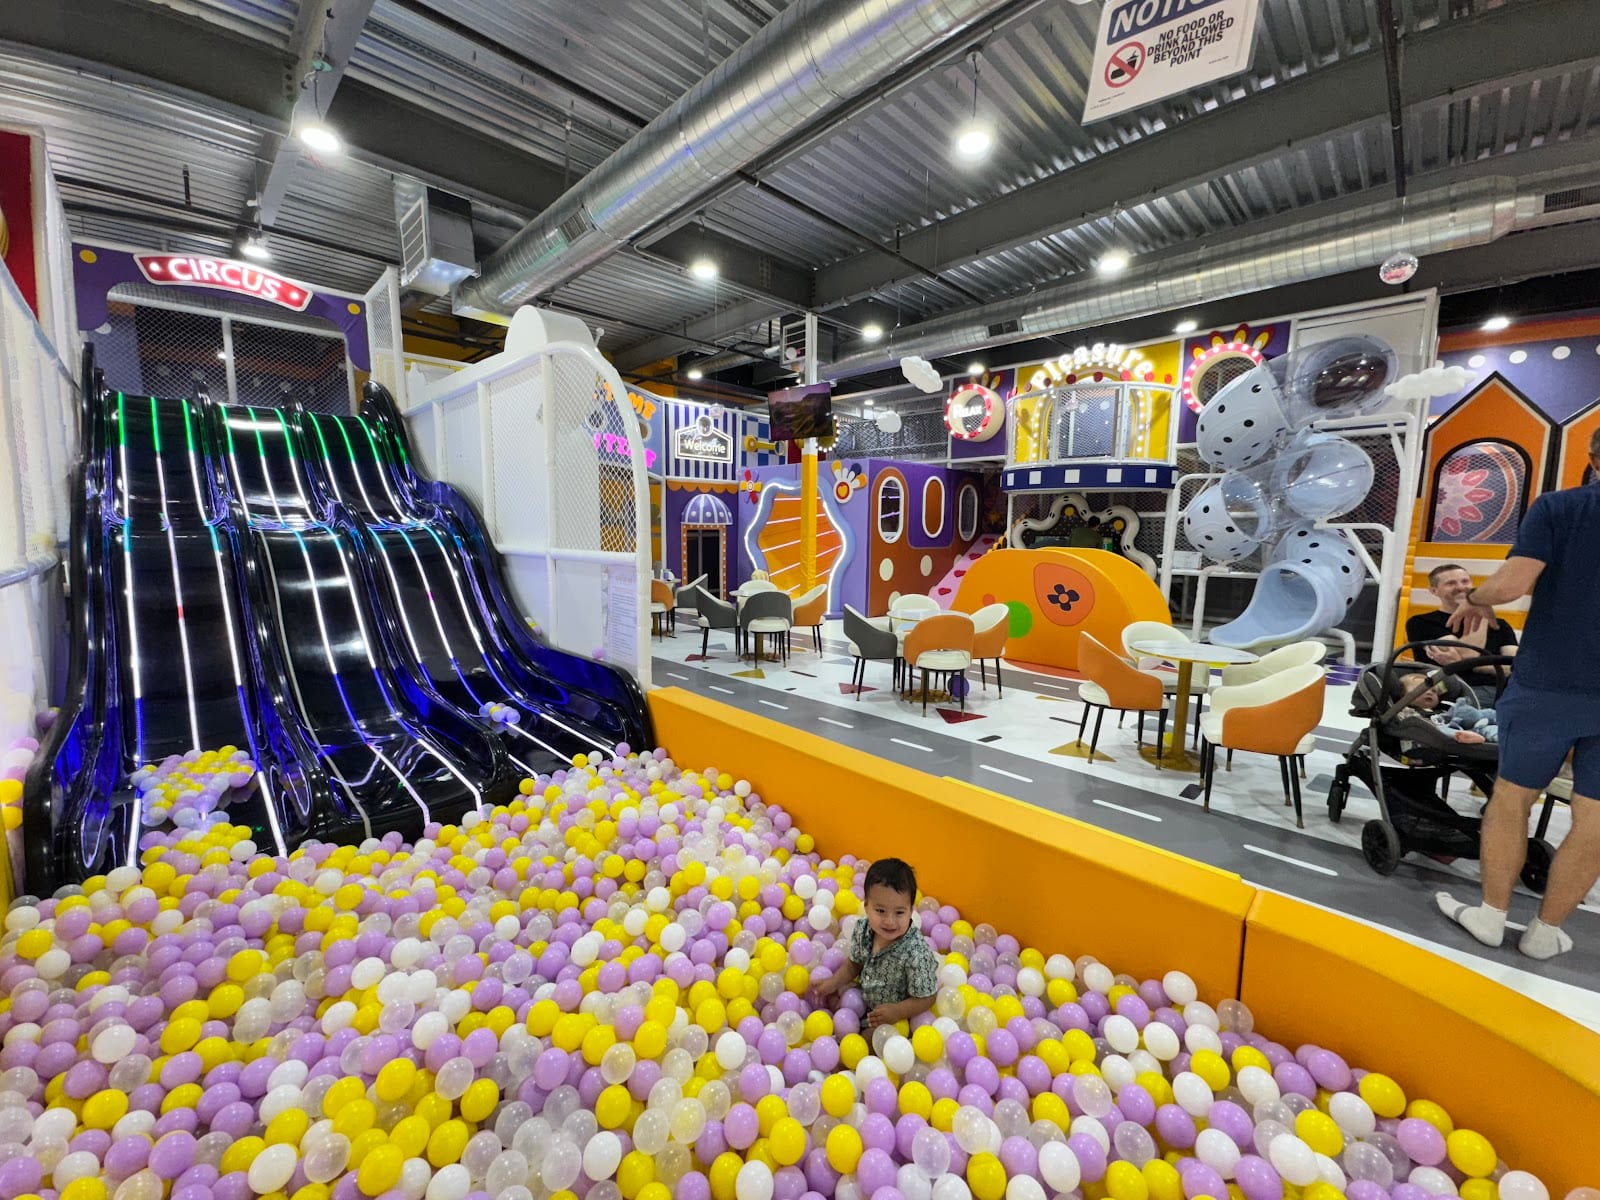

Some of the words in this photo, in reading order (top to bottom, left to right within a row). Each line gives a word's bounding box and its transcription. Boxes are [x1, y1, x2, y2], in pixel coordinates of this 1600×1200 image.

[1147, 37, 1179, 56] DRINK
[1181, 17, 1234, 44] ALLOWED
[1159, 29, 1174, 42] NO
[1176, 17, 1205, 36] FOOD
[1208, 10, 1224, 24] OR
[1153, 41, 1195, 64] BEYOND
[1198, 31, 1223, 48] THIS
[1170, 48, 1202, 68] POINT
[167, 257, 282, 299] CIRCUS
[1030, 342, 1155, 390] Pleasure
[683, 439, 726, 453] Welcome
